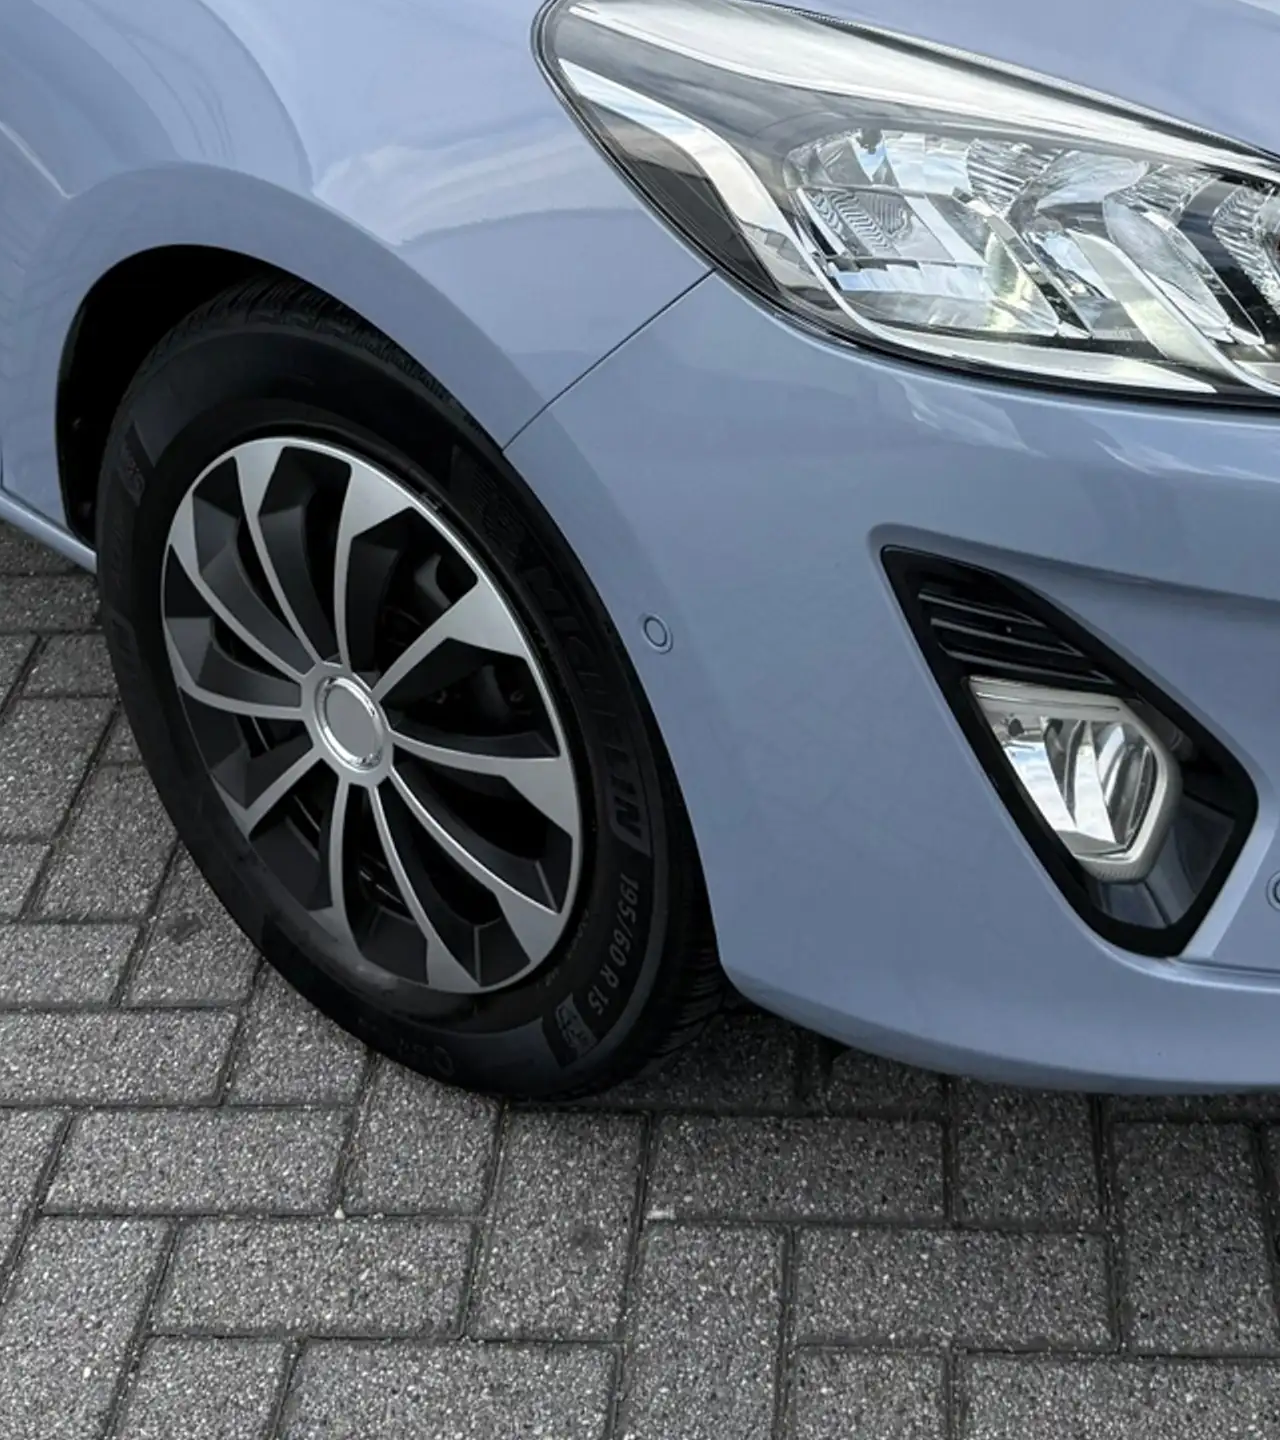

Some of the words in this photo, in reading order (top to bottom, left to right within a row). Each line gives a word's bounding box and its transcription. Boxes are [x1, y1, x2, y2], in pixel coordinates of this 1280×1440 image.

[524, 566, 643, 840] MICHELIN
[609, 873, 639, 967] 195/60
[587, 984, 610, 1016] 15
[599, 963, 619, 988] R
